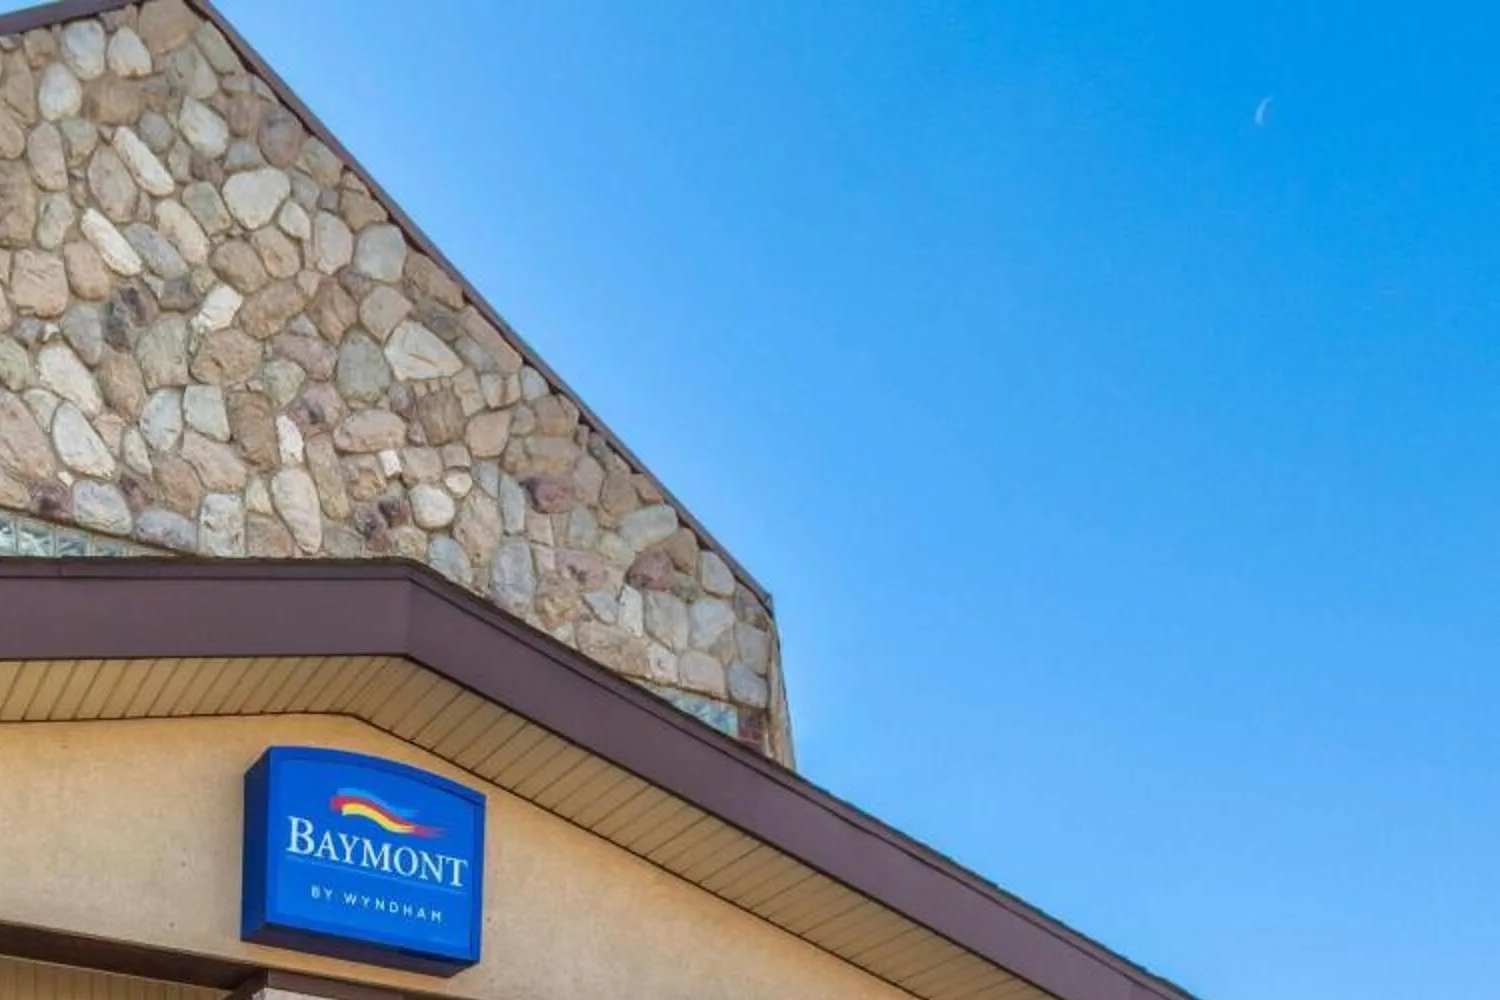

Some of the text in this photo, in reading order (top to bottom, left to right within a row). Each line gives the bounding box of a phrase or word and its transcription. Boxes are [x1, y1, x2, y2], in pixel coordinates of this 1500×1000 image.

[286, 815, 468, 887] BAYMONT
[310, 885, 442, 922] BY WYNDHAM
